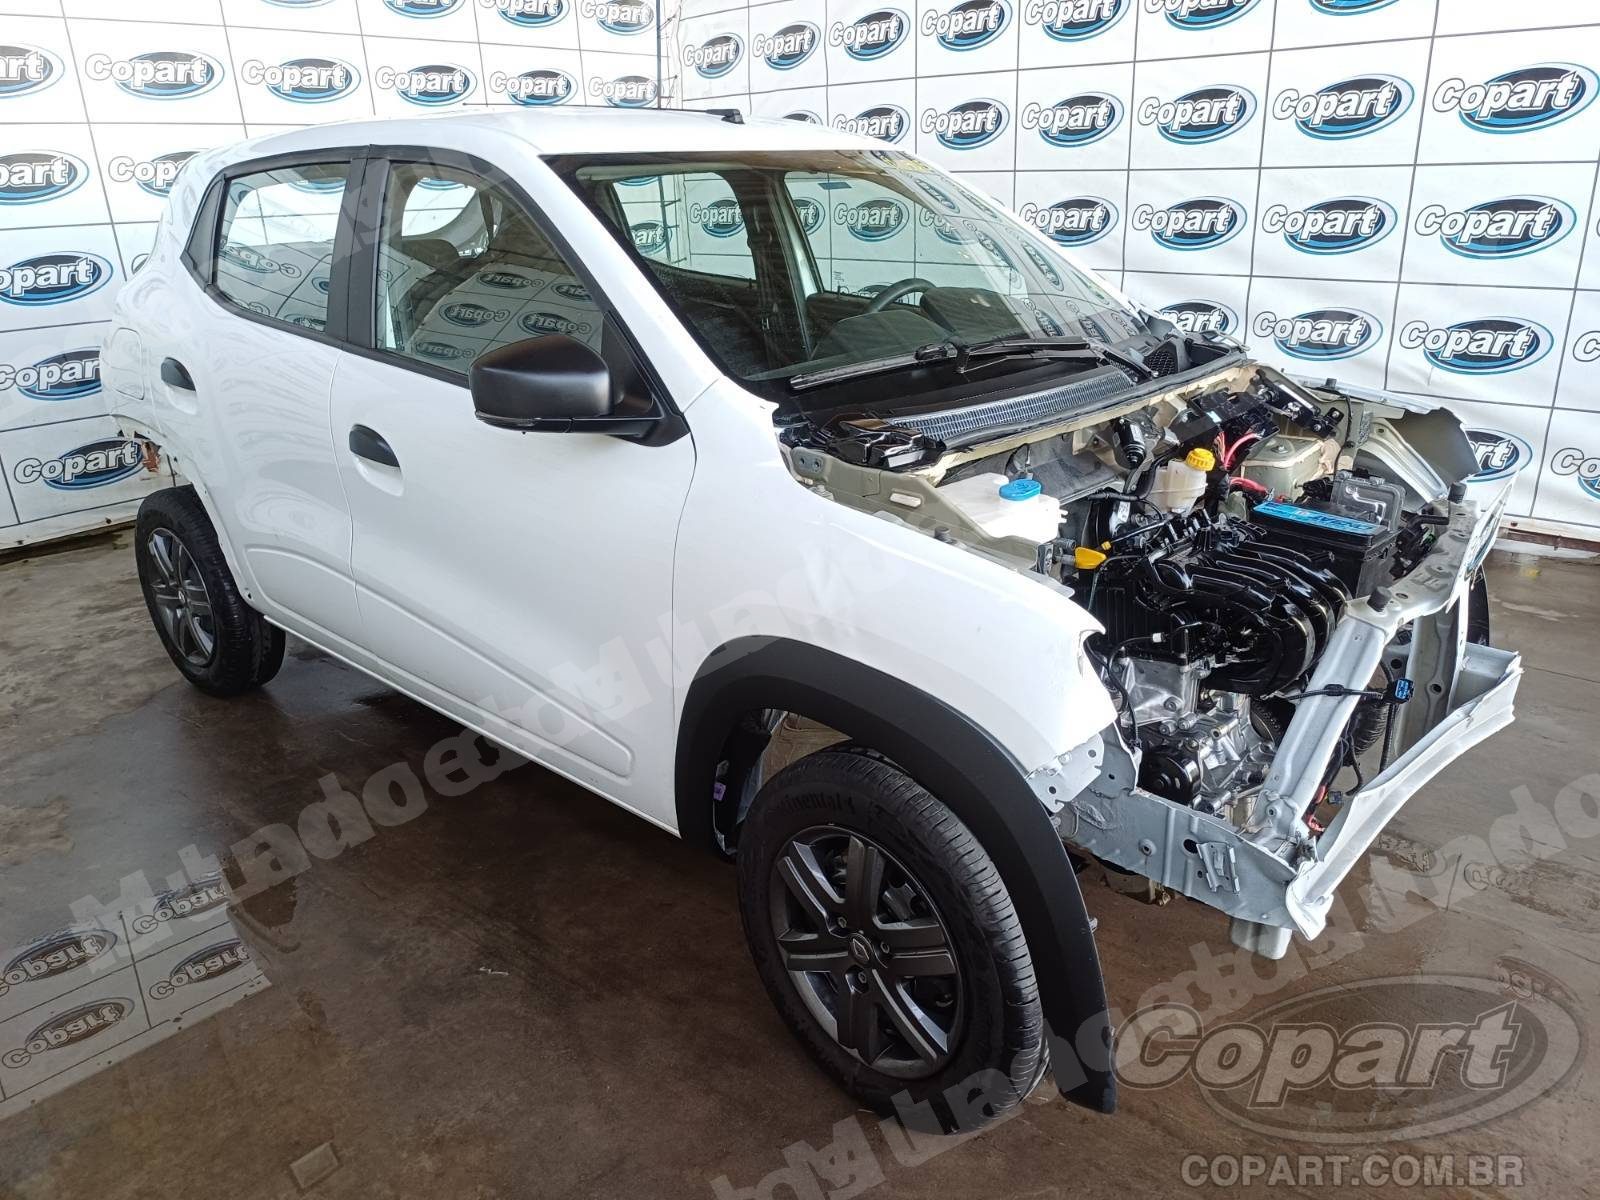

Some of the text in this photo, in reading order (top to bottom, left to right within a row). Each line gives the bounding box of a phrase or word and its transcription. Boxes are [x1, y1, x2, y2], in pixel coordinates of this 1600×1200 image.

[582, 0, 652, 25] Copart
[921, 1, 1001, 35] Copart
[1025, 0, 1113, 30] Copart
[752, 28, 813, 61] Copart
[829, 20, 899, 51] Copart
[85, 53, 208, 88] Copart
[683, 39, 738, 68] Copart
[242, 60, 346, 92] Copart
[375, 66, 464, 96] Copart
[489, 71, 567, 99] Copart
[589, 77, 656, 99] Copart
[1137, 91, 1241, 132] Copart
[1273, 82, 1398, 126] Copart
[1433, 71, 1580, 121] Copart
[920, 103, 1000, 139] Copart
[1021, 98, 1111, 136] Copart
[108, 155, 185, 189] Cop
[834, 202, 900, 229] Copart
[1020, 202, 1105, 235] Copart
[1131, 203, 1231, 238] Copart
[1262, 204, 1378, 241] Copart
[1414, 204, 1556, 245] Copart
[0, 257, 95, 296] part
[1253, 311, 1366, 347] Copart
[1400, 320, 1534, 360] Copart
[0, 359, 100, 391] Copar
[14, 440, 139, 484] Copart
